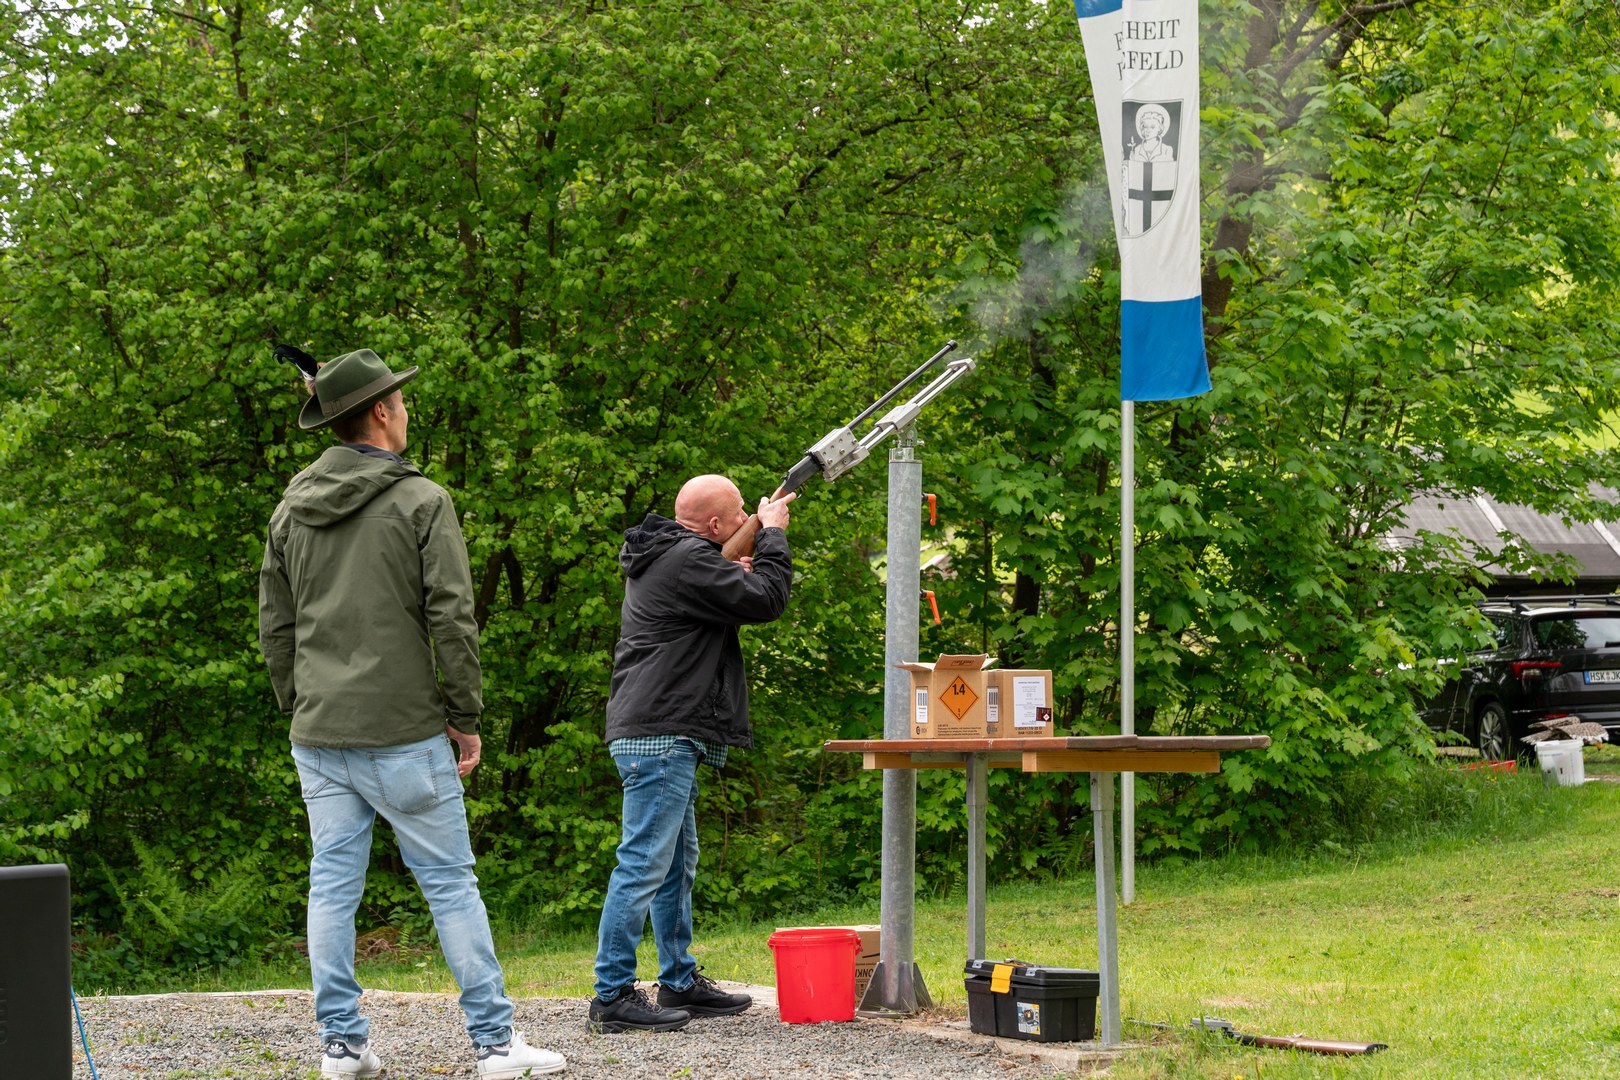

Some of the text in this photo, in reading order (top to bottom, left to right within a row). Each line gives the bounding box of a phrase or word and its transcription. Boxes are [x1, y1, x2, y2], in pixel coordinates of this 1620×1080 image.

[1122, 19, 1180, 40] HEIT
[1590, 671, 1605, 681] HSK
[952, 683, 965, 695] 1.4
